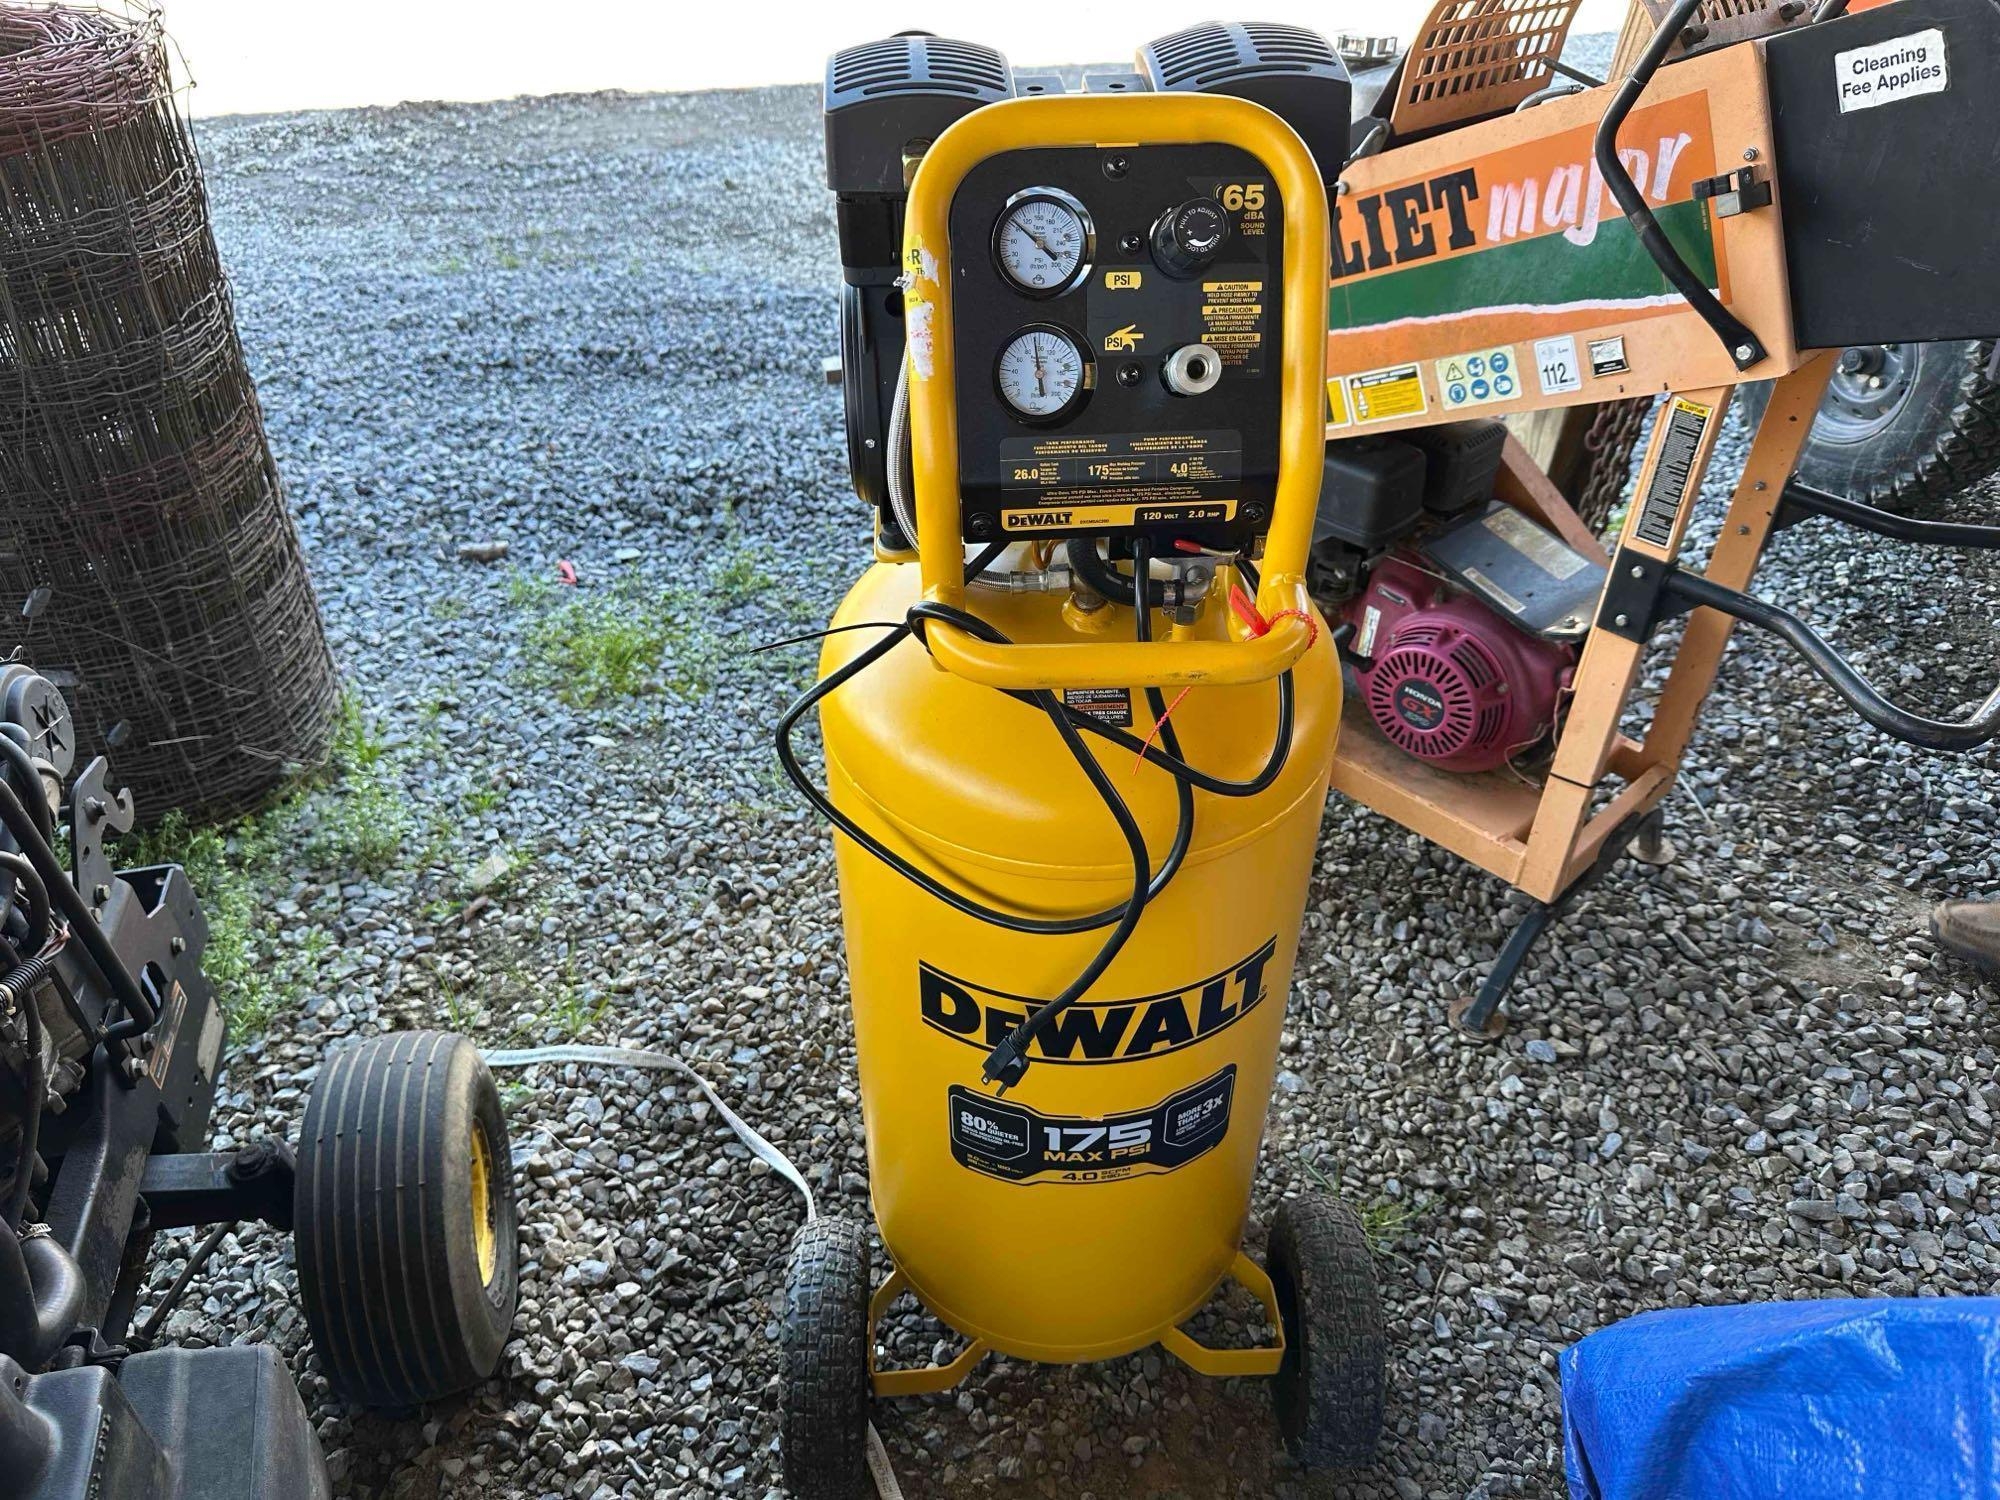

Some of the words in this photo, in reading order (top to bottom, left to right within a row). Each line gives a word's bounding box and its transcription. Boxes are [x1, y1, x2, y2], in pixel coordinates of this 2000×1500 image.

[1853, 47, 1927, 75] Cleaning
[1842, 82, 1872, 98] Fee
[1877, 65, 1941, 91] Applies
[1486, 132, 1692, 246] major
[1223, 184, 1265, 211] 65
[1197, 207, 1218, 220] ADJUST
[1244, 212, 1265, 220] dBA
[1114, 275, 1131, 286] PSI
[1107, 337, 1122, 348] PSI
[1543, 362, 1569, 386] 112
[1015, 469, 1039, 480] 26.0
[1088, 465, 1109, 476] 175
[1171, 463, 1188, 473] 4.0
[1143, 512, 1162, 520] 120
[1188, 510, 1205, 518] 2.0
[1404, 686, 1443, 710] HONDA
[1402, 697, 1438, 720] GX
[1178, 1104, 1202, 1121] MORE
[1178, 1112, 1201, 1127] THAN
[961, 1111, 999, 1132] 80%
[987, 1129, 1019, 1141] QUIETER
[1044, 1119, 1153, 1152] 175
[1044, 1151, 1104, 1162] MAX
[1111, 1143, 1151, 1160] PSI
[1062, 1172, 1098, 1181] 4.0
